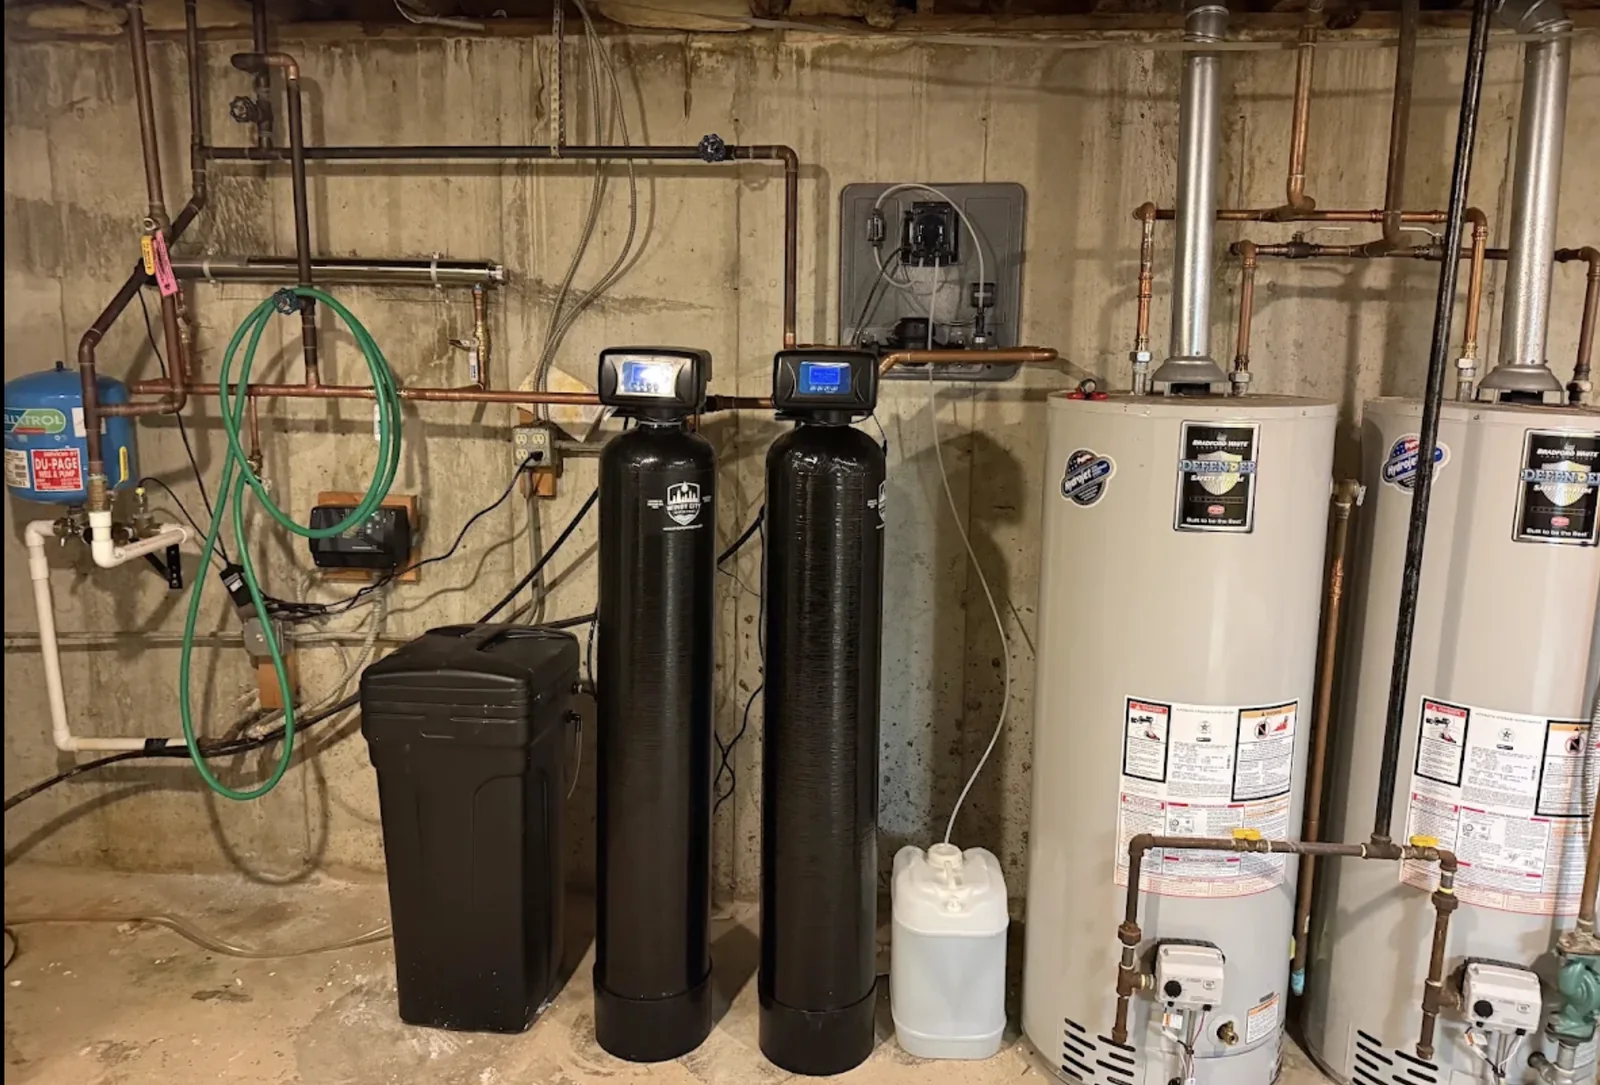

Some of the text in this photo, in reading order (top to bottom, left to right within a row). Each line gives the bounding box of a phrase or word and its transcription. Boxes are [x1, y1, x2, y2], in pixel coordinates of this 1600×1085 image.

[1536, 448, 1575, 457] BRADFORD
[35, 458, 78, 470] DU-PAGE
[1182, 460, 1256, 473] DEFENDER
[59, 470, 75, 478] PUMP
